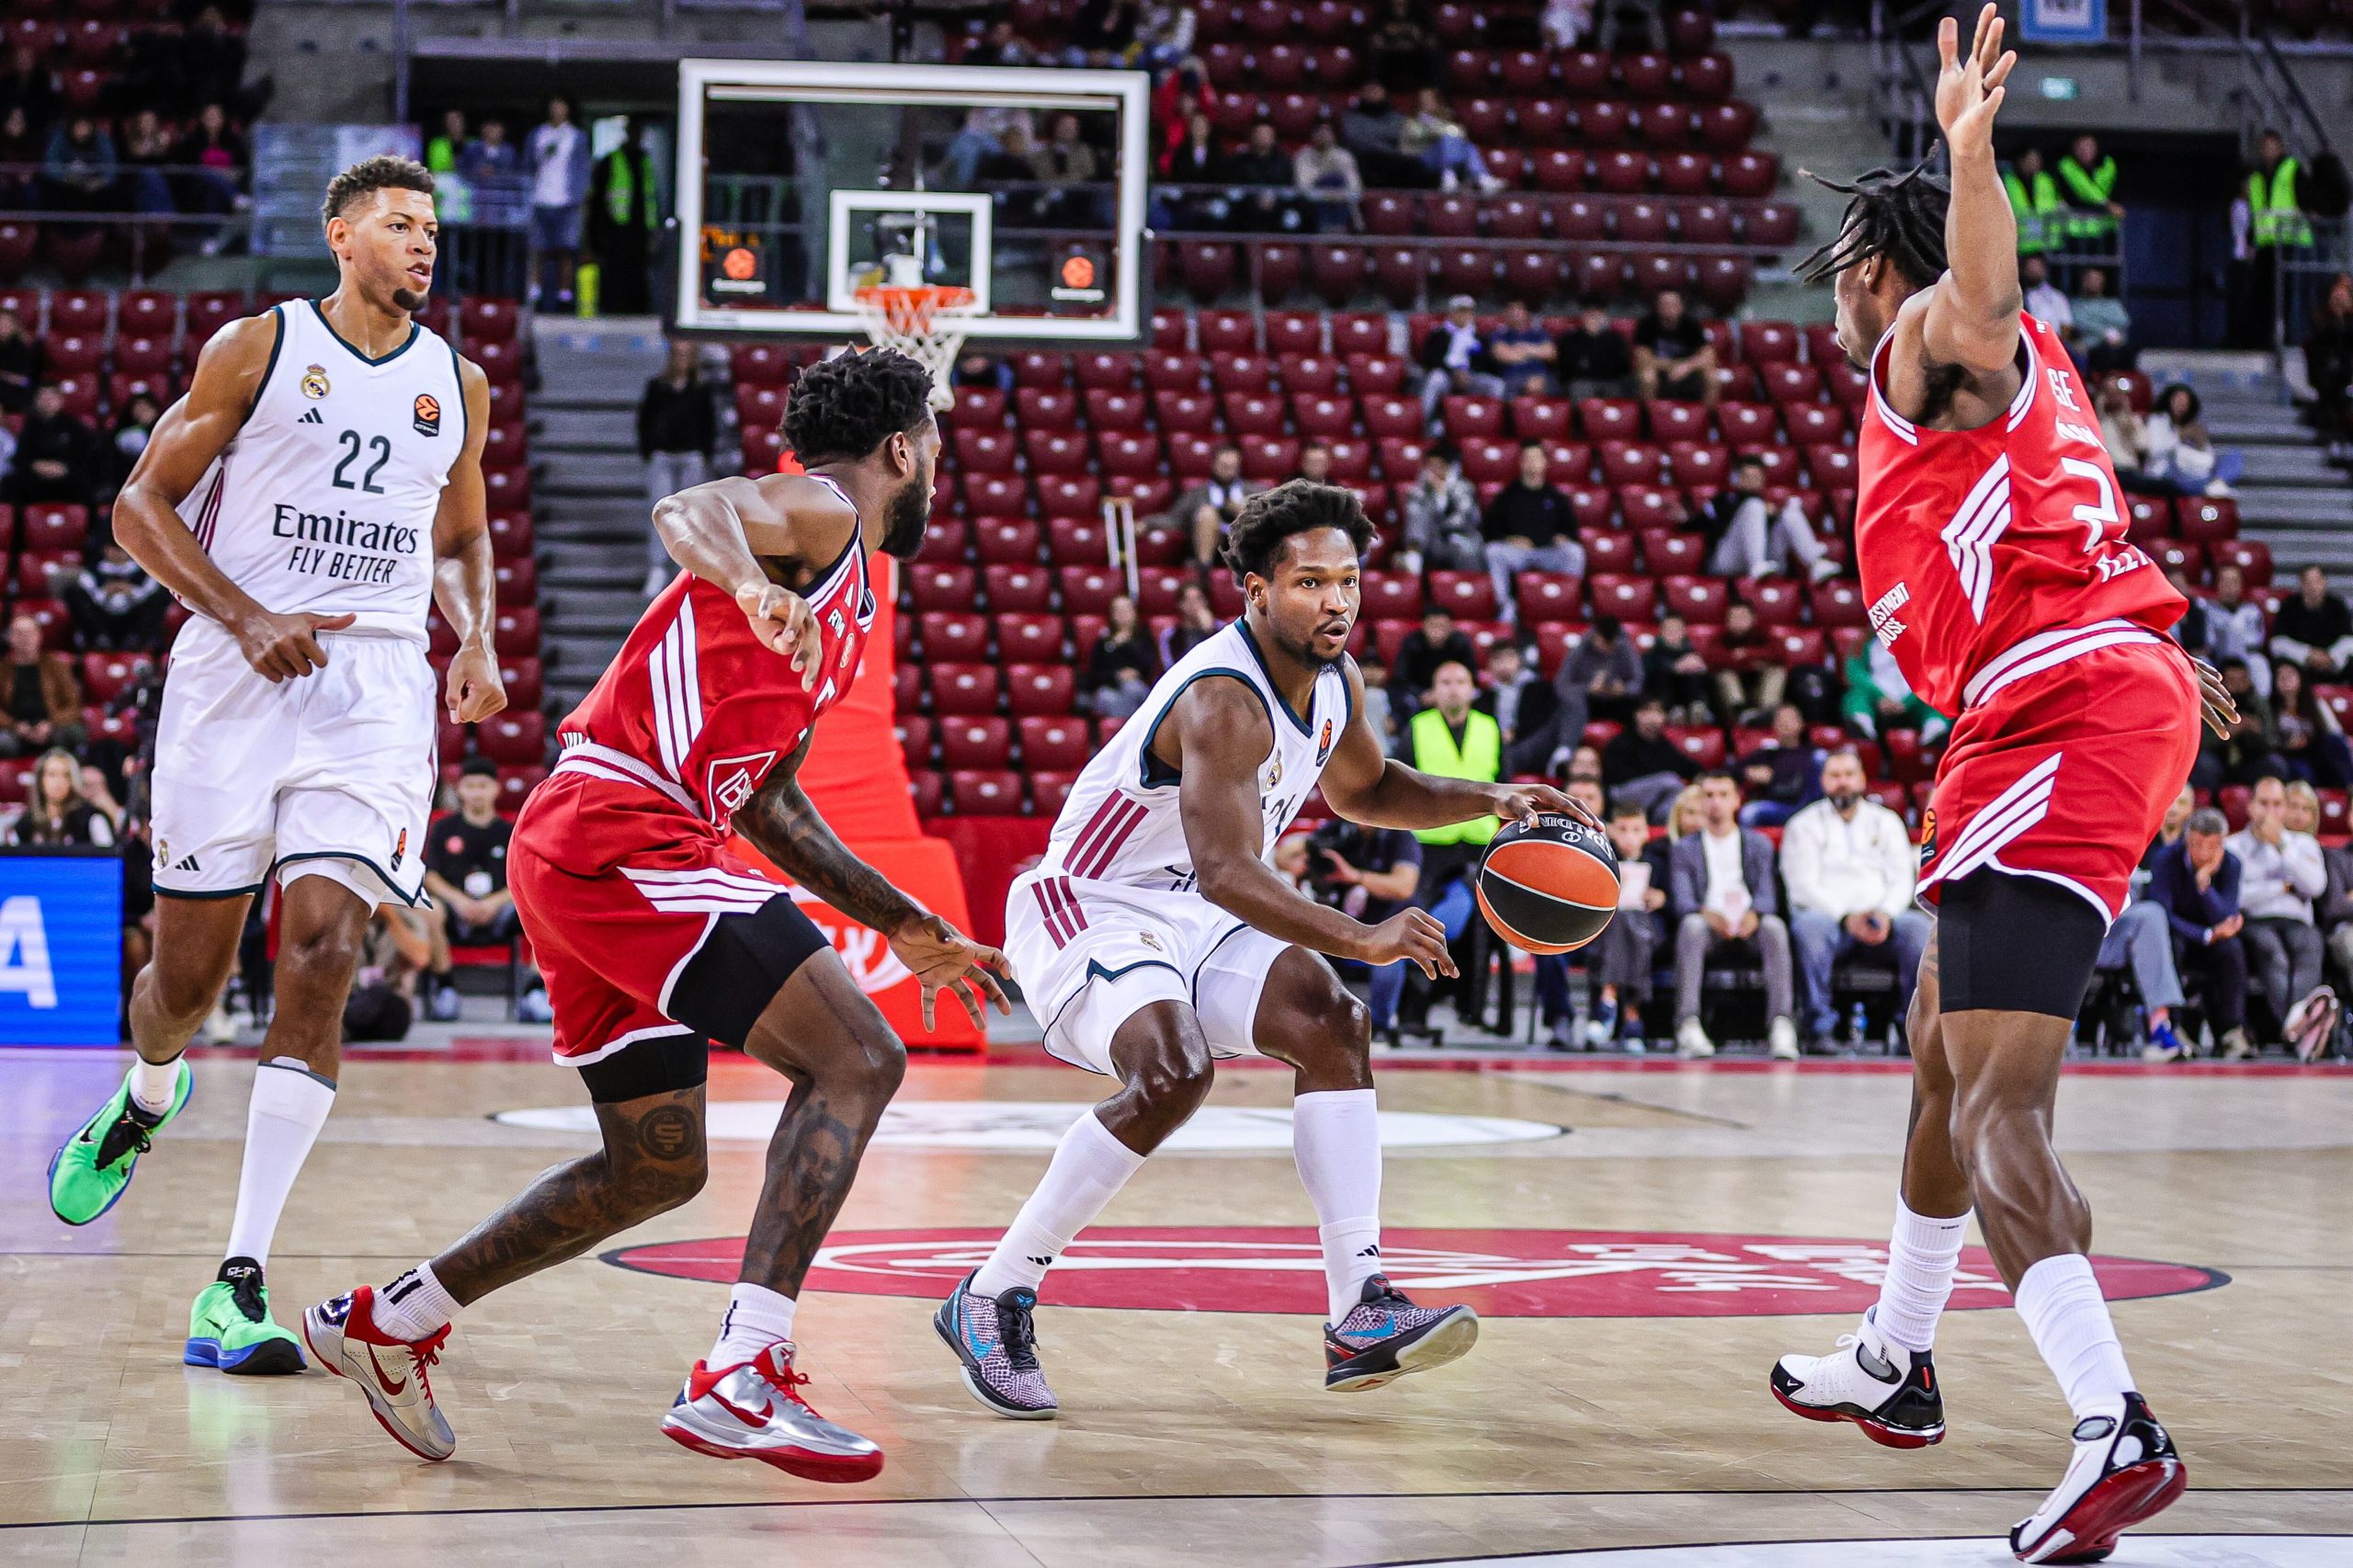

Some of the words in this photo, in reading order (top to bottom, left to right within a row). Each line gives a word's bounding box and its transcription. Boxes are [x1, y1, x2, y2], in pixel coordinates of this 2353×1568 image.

[332, 429, 392, 494] 22
[272, 503, 419, 554] Emirates
[288, 546, 326, 575] FLY
[327, 551, 398, 585] BETTER
[0, 894, 59, 1009] A
